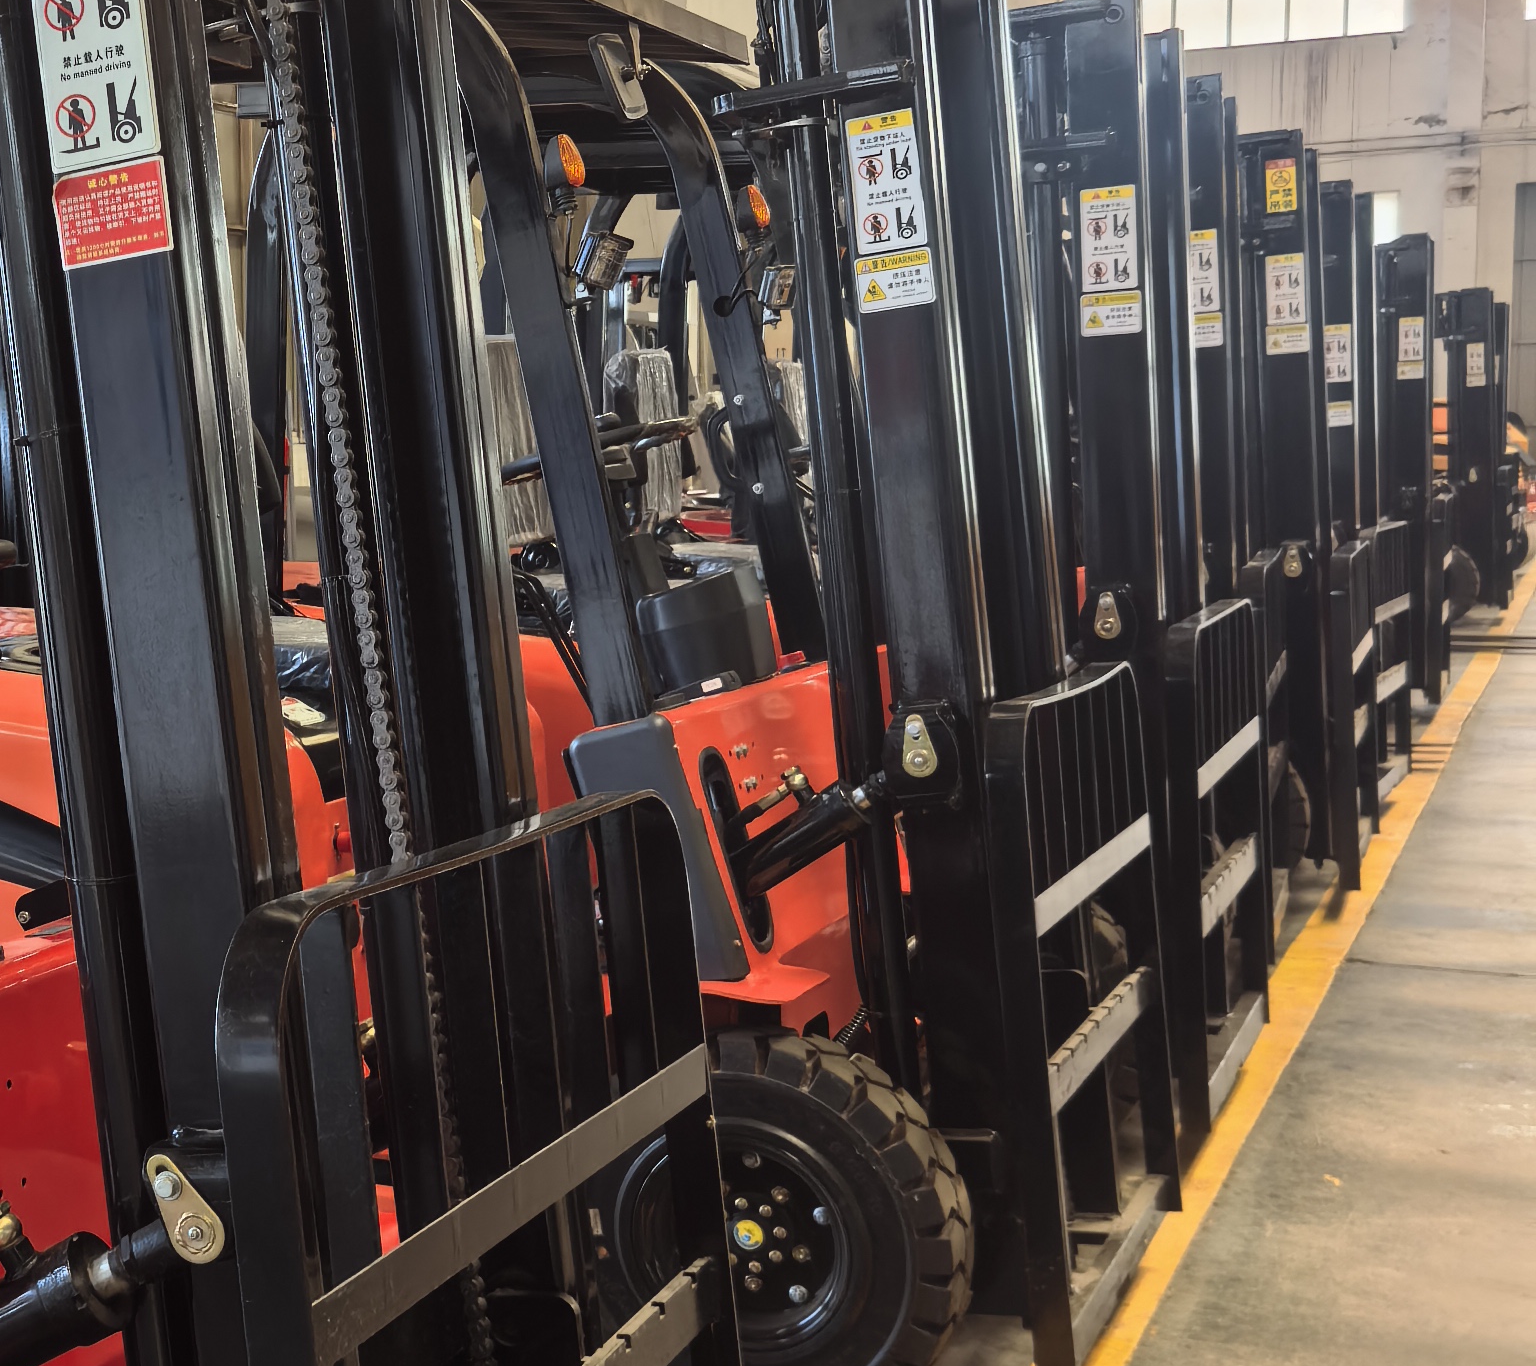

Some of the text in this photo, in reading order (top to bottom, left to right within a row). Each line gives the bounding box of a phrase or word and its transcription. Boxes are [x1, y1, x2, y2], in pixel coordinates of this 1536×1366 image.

[63, 44, 124, 69] 禁止载人行驶
[60, 73, 71, 82] No
[104, 60, 131, 72] driving
